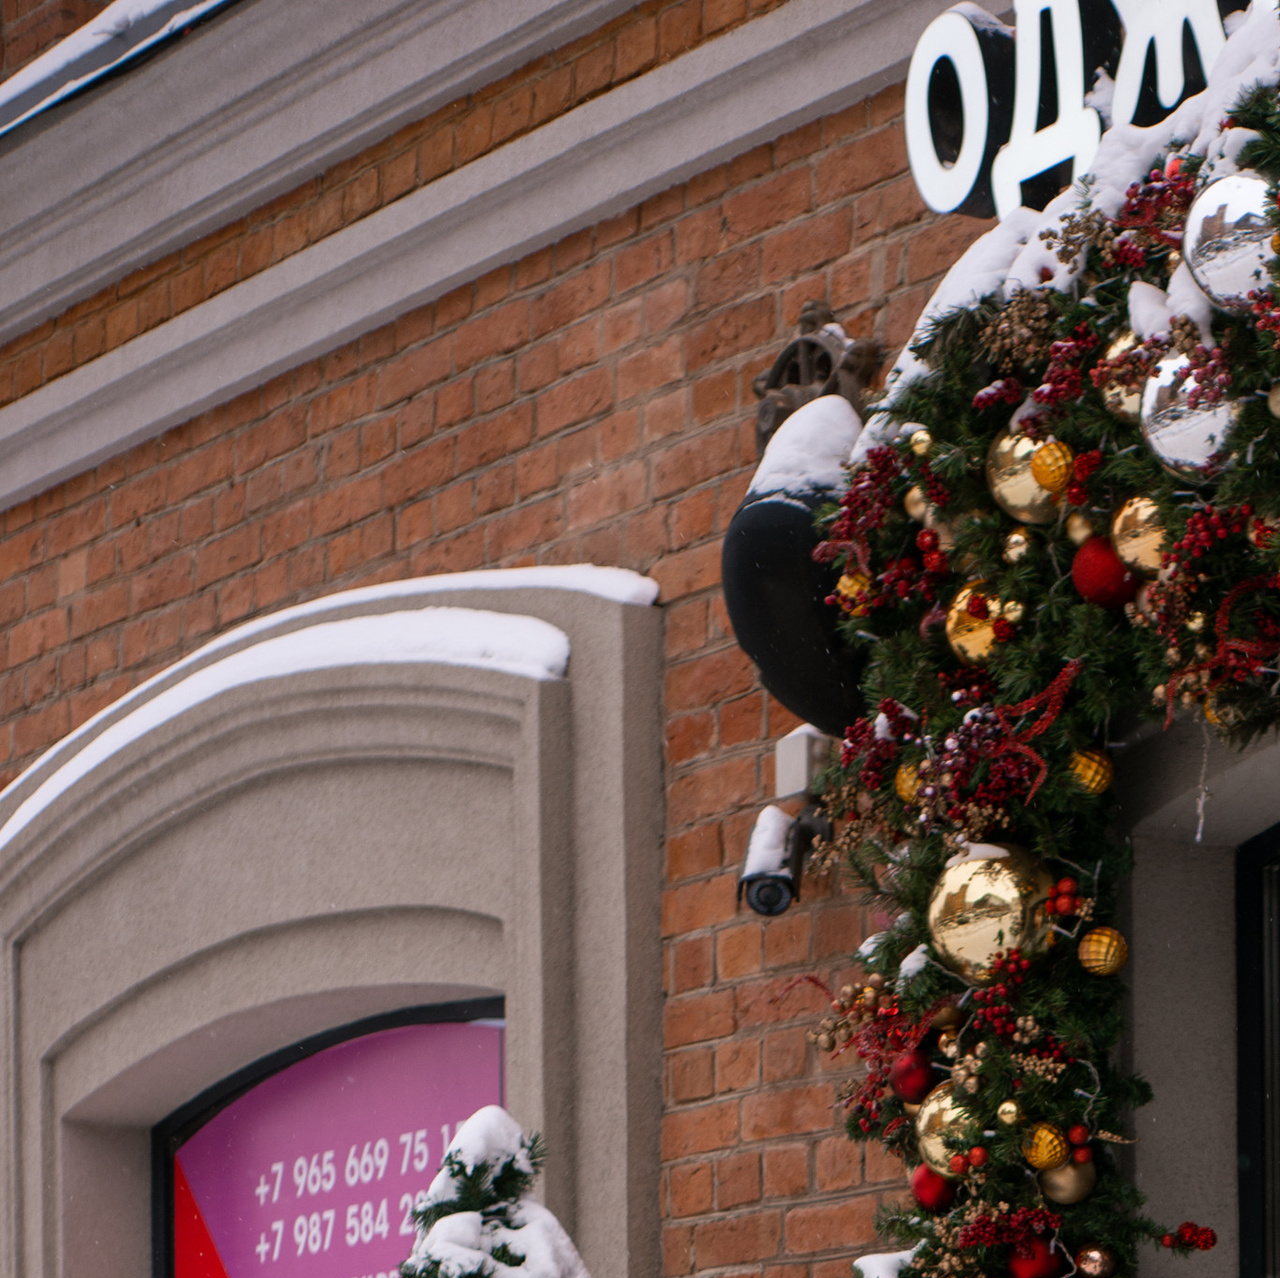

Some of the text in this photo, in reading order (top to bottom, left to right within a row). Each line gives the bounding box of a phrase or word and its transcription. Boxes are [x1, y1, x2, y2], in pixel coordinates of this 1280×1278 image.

[255, 1161, 284, 1206] +7
[293, 1150, 336, 1198] 965
[345, 1137, 389, 1187] 669
[399, 1128, 429, 1175] 75
[255, 1219, 284, 1264] +7
[293, 1209, 335, 1257] 987
[345, 1198, 389, 1247] 584
